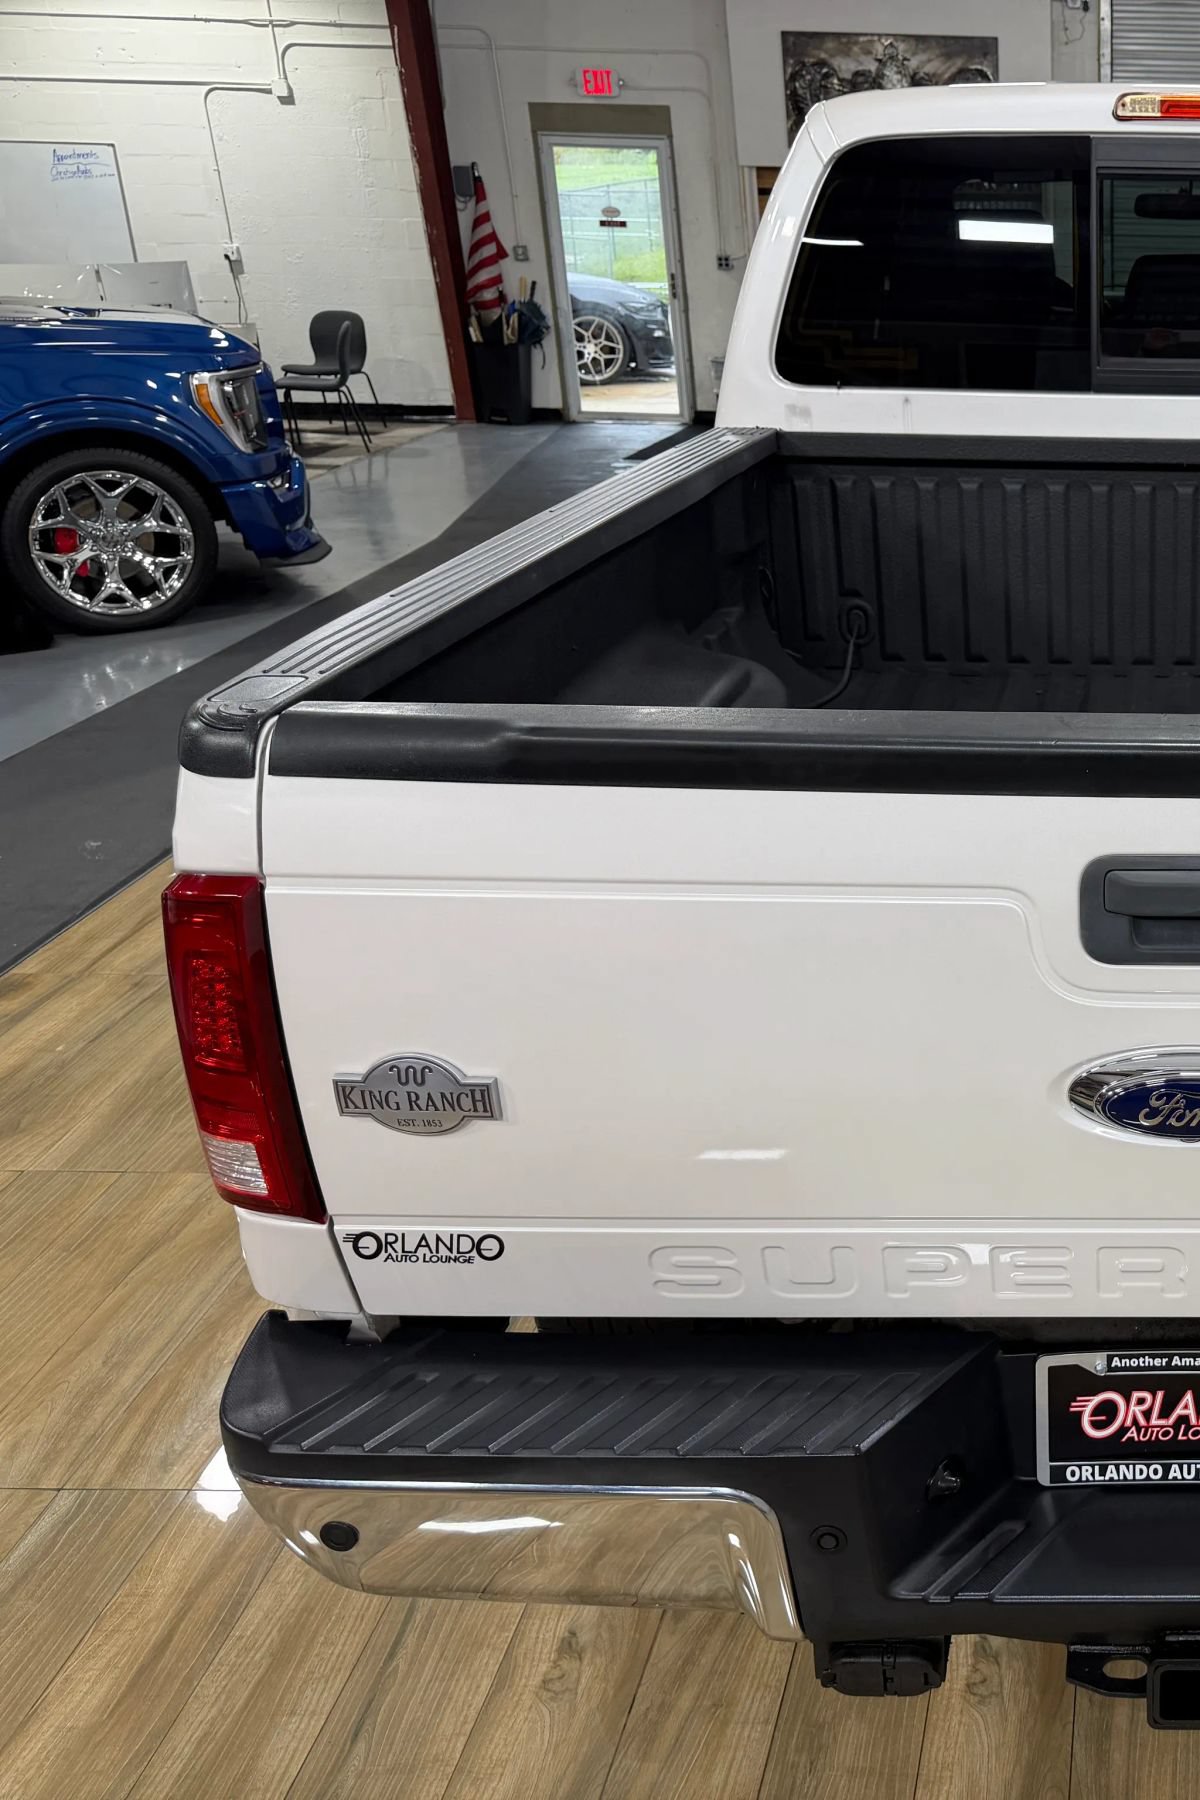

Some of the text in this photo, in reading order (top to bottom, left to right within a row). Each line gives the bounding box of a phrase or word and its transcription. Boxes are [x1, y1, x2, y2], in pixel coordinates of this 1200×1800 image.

[583, 69, 613, 96] EXIT
[340, 1085, 490, 1113] KING RANCH
[397, 1118, 443, 1128] EST. 1853
[350, 1231, 505, 1262] ORLANDO
[384, 1253, 476, 1264] AUTO LOUNGE
[648, 1244, 1188, 1299] SUPER
[1111, 1355, 1169, 1368] Another
[1121, 1426, 1175, 1442] AUTO
[1065, 1464, 1163, 1482] ORLANDO
